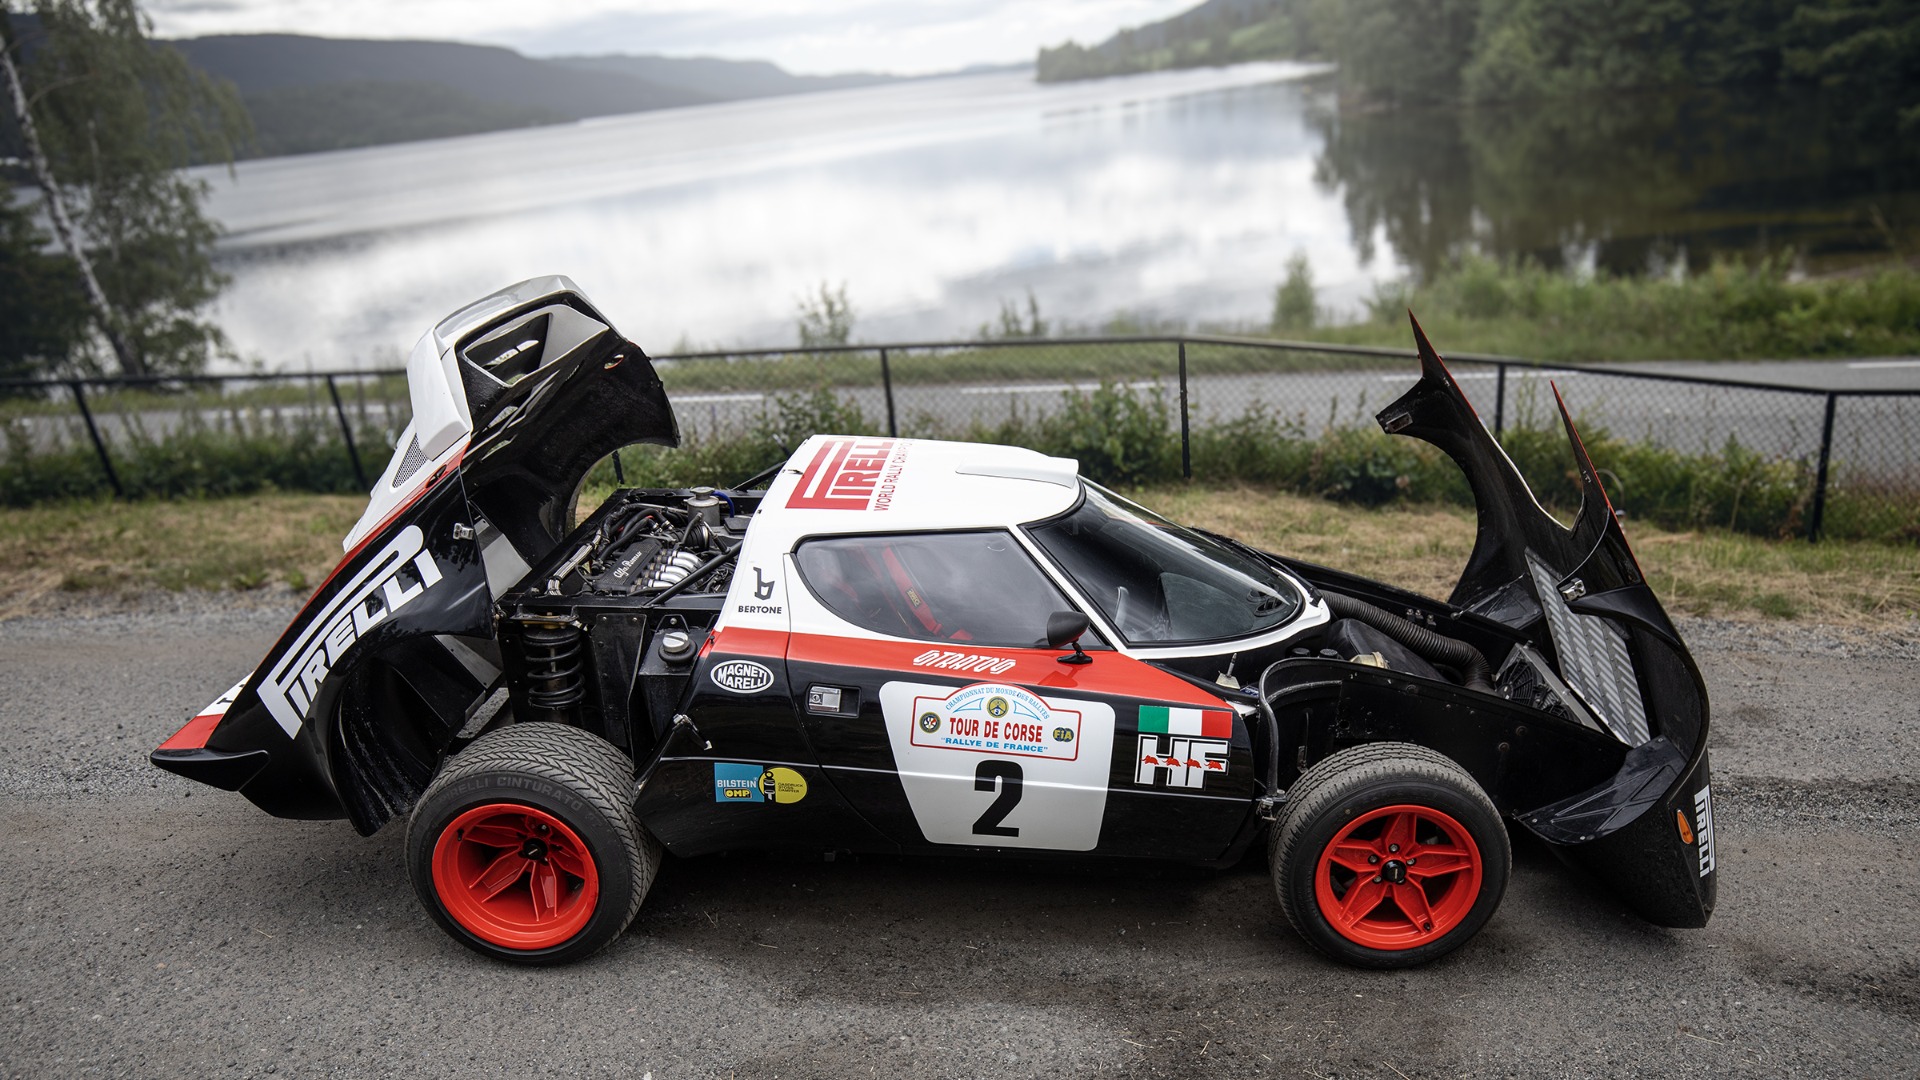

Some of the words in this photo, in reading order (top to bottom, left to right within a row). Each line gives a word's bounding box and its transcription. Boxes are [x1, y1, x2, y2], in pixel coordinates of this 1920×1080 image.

[785, 436, 897, 511] PIRELLI
[884, 463, 904, 484] RALLY
[874, 483, 897, 512] WORLD
[613, 565, 630, 579] Alfa
[738, 605, 782, 615] BERTONE
[256, 525, 443, 740] PIRELLI
[718, 664, 767, 680] MAGNETI
[718, 673, 767, 690] MARELLI
[945, 687, 985, 711] CHAMPIONNAT
[995, 687, 1018, 697] MONDE
[1017, 693, 1029, 703] DES
[1028, 698, 1050, 720] RALLYES
[950, 717, 979, 737] TOUR
[984, 721, 999, 739] DE
[1003, 722, 1043, 743] CORSE
[986, 741, 999, 749] DE
[1134, 734, 1231, 790] HF
[496, 776, 583, 812] CINTURATO
[717, 779, 757, 788] BILSTEIN
[725, 789, 750, 797] OMP
[972, 760, 1024, 838] 2
[1694, 784, 1715, 878] PIRELLI
